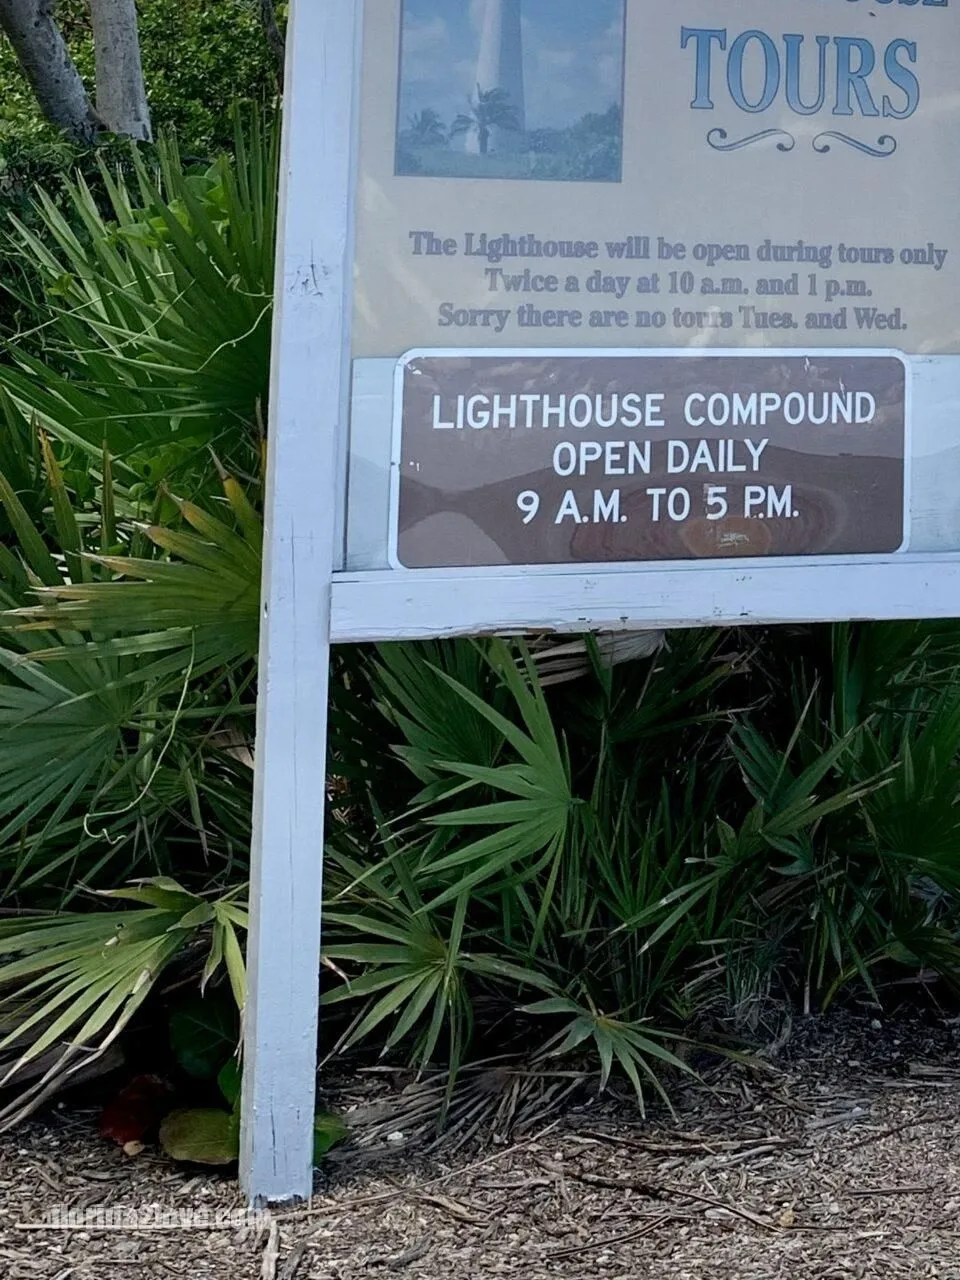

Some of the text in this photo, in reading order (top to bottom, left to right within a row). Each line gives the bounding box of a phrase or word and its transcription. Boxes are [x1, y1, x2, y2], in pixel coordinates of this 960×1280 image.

[680, 25, 920, 120] TOURS
[408, 230, 948, 271] The Lighthouse will be open during tours only
[484, 267, 873, 302] Twice a day at 10 a.m. and 1 p.m.
[437, 302, 908, 333] Sorry there are no tours Tues. and Wed.
[432, 390, 877, 430] LIGHTHOUSE COMPOUND
[552, 438, 769, 477] OPEN DAILY
[516, 484, 800, 525] 9 A.M. TO 5 P.M.
